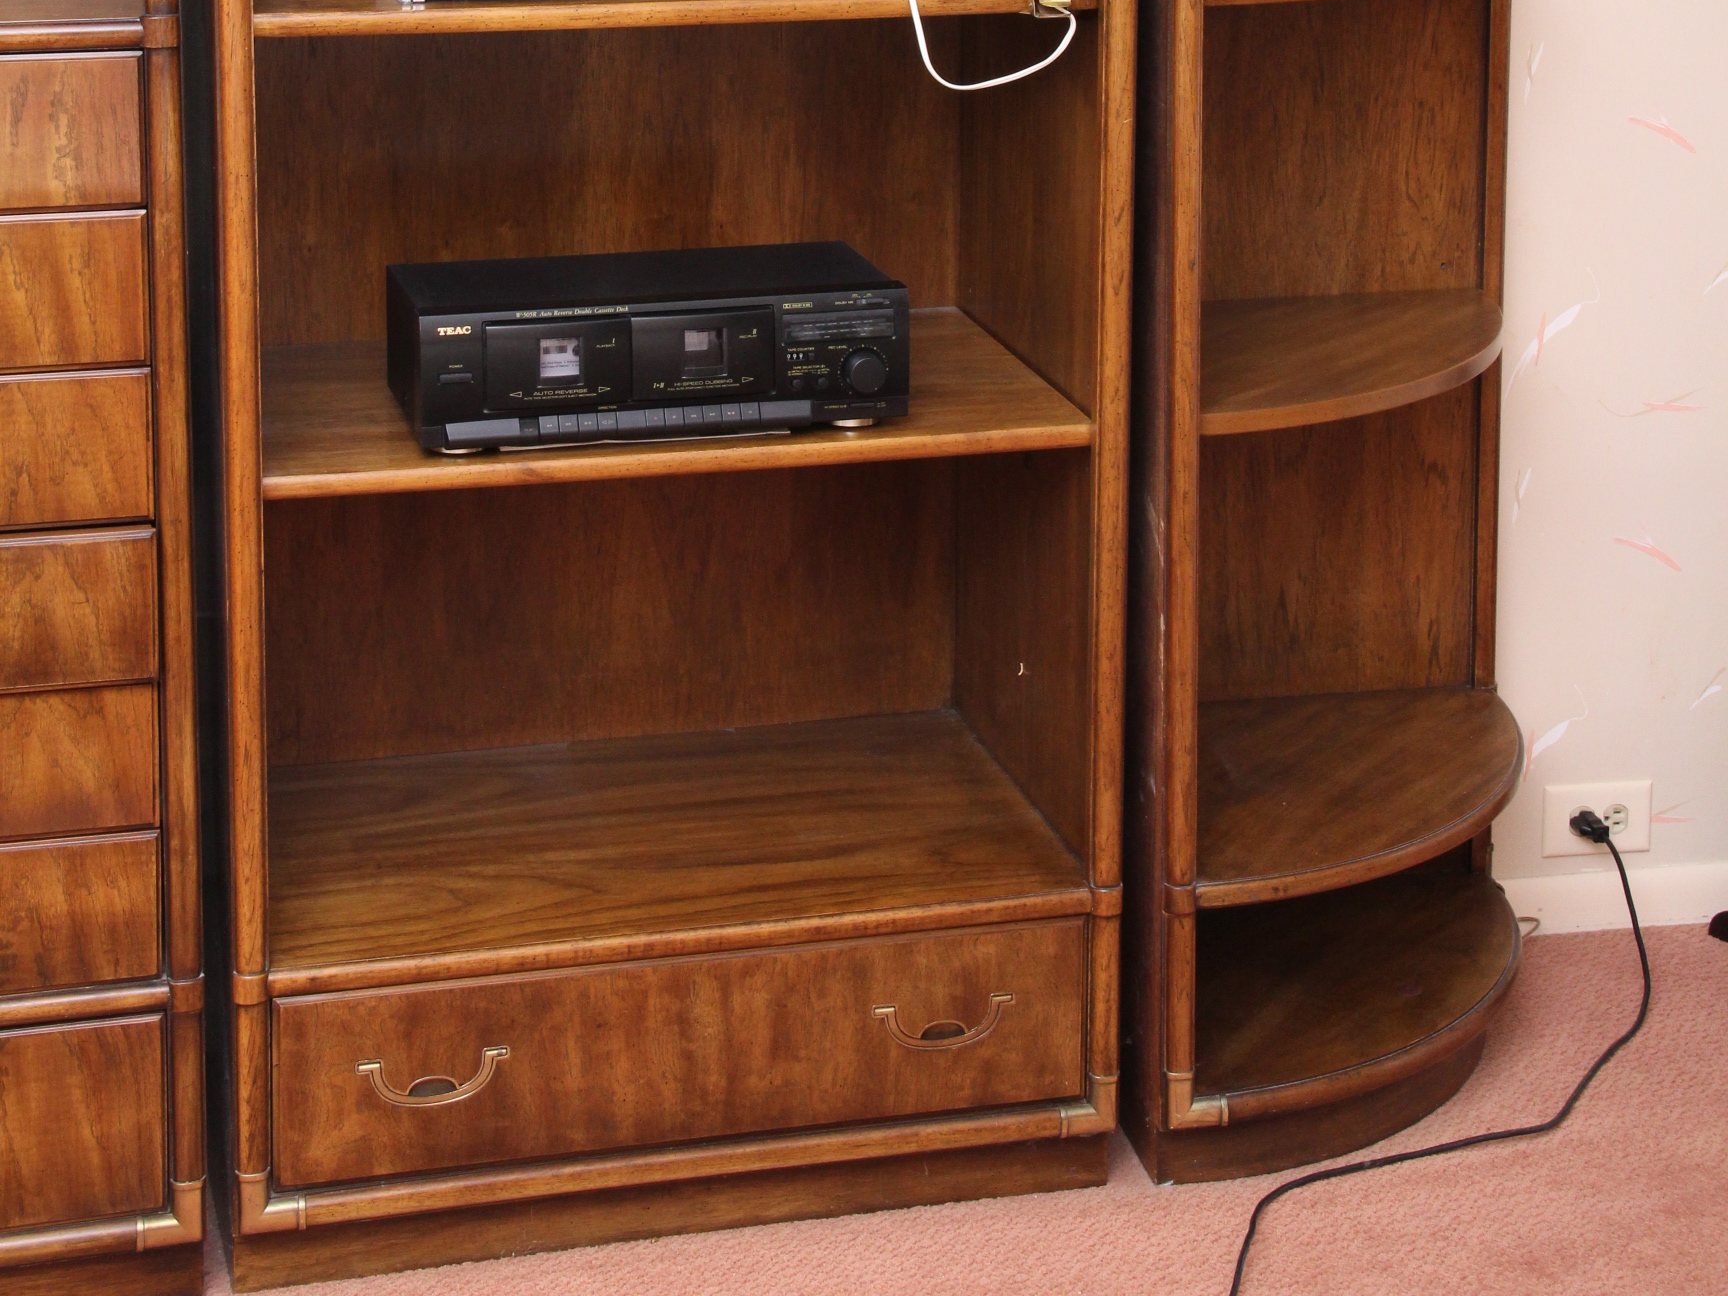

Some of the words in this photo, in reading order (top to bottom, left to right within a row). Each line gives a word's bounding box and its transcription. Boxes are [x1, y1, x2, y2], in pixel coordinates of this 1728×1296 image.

[594, 306, 615, 314] Cassette
[616, 305, 629, 313] Deck
[437, 325, 472, 336] TEAC
